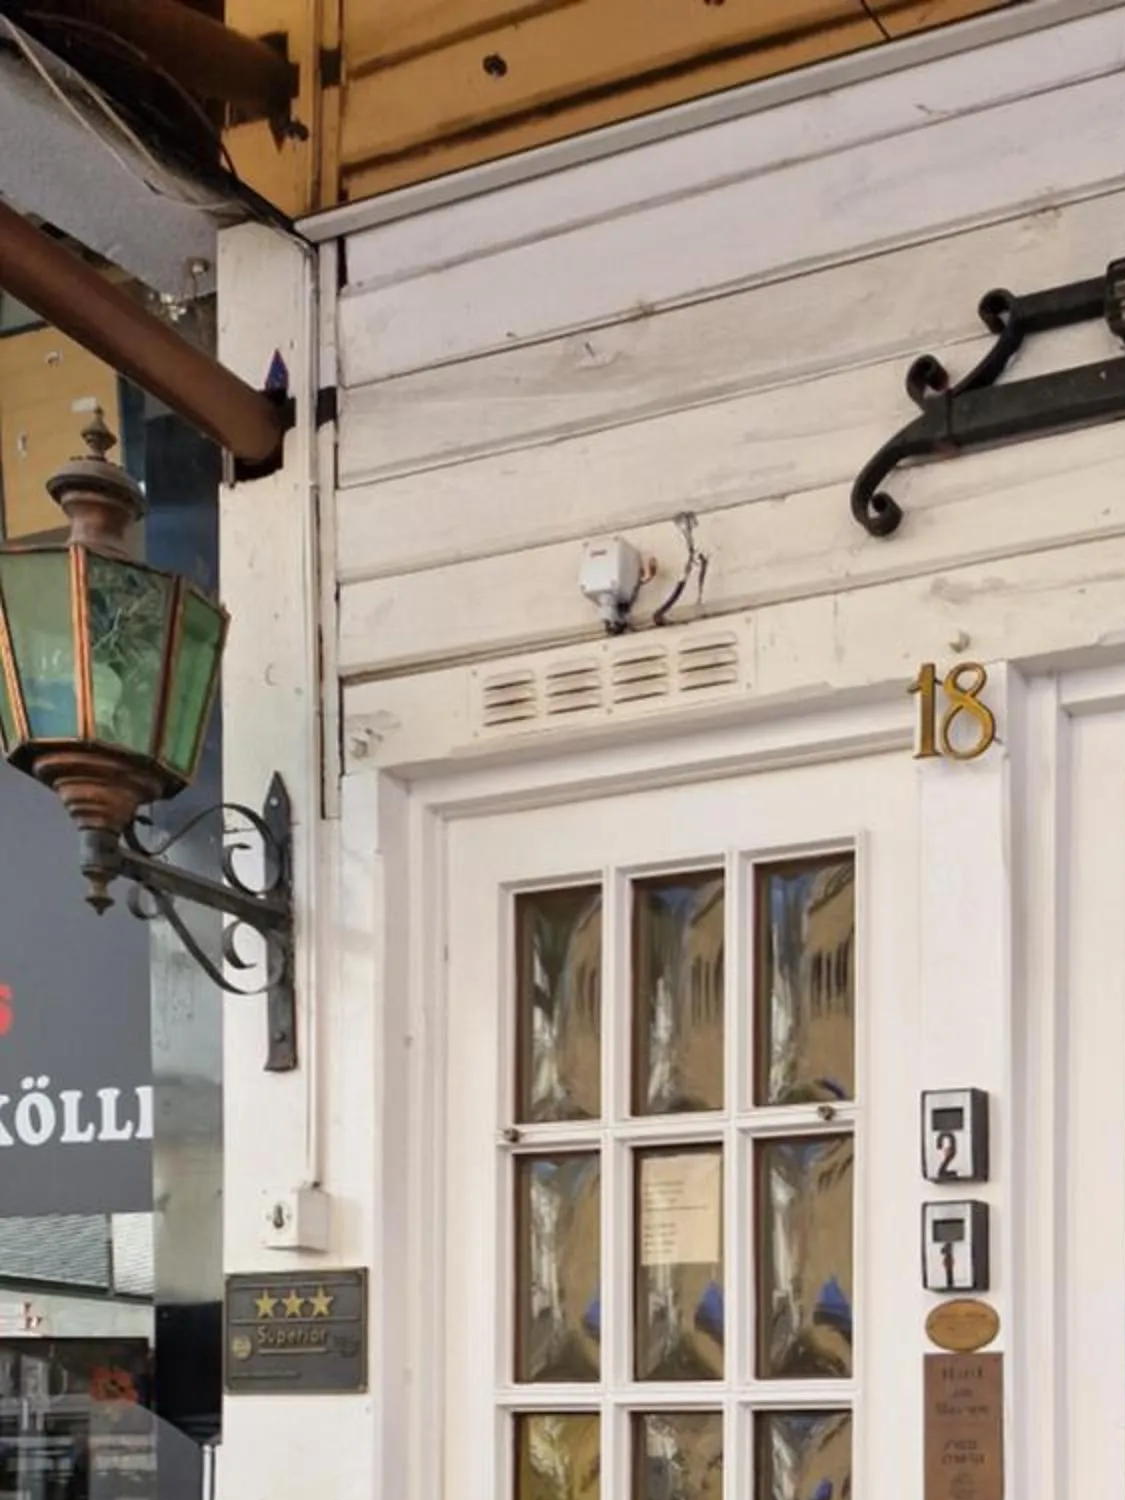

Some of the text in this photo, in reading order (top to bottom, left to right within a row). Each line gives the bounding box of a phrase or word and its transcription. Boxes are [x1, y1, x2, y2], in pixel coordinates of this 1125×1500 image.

[907, 661, 996, 760] 18
[0, 1074, 153, 1147] ÖLL
[936, 1132, 958, 1178] 2
[941, 1242, 954, 1288] 1
[256, 1325, 327, 1348] Superior
